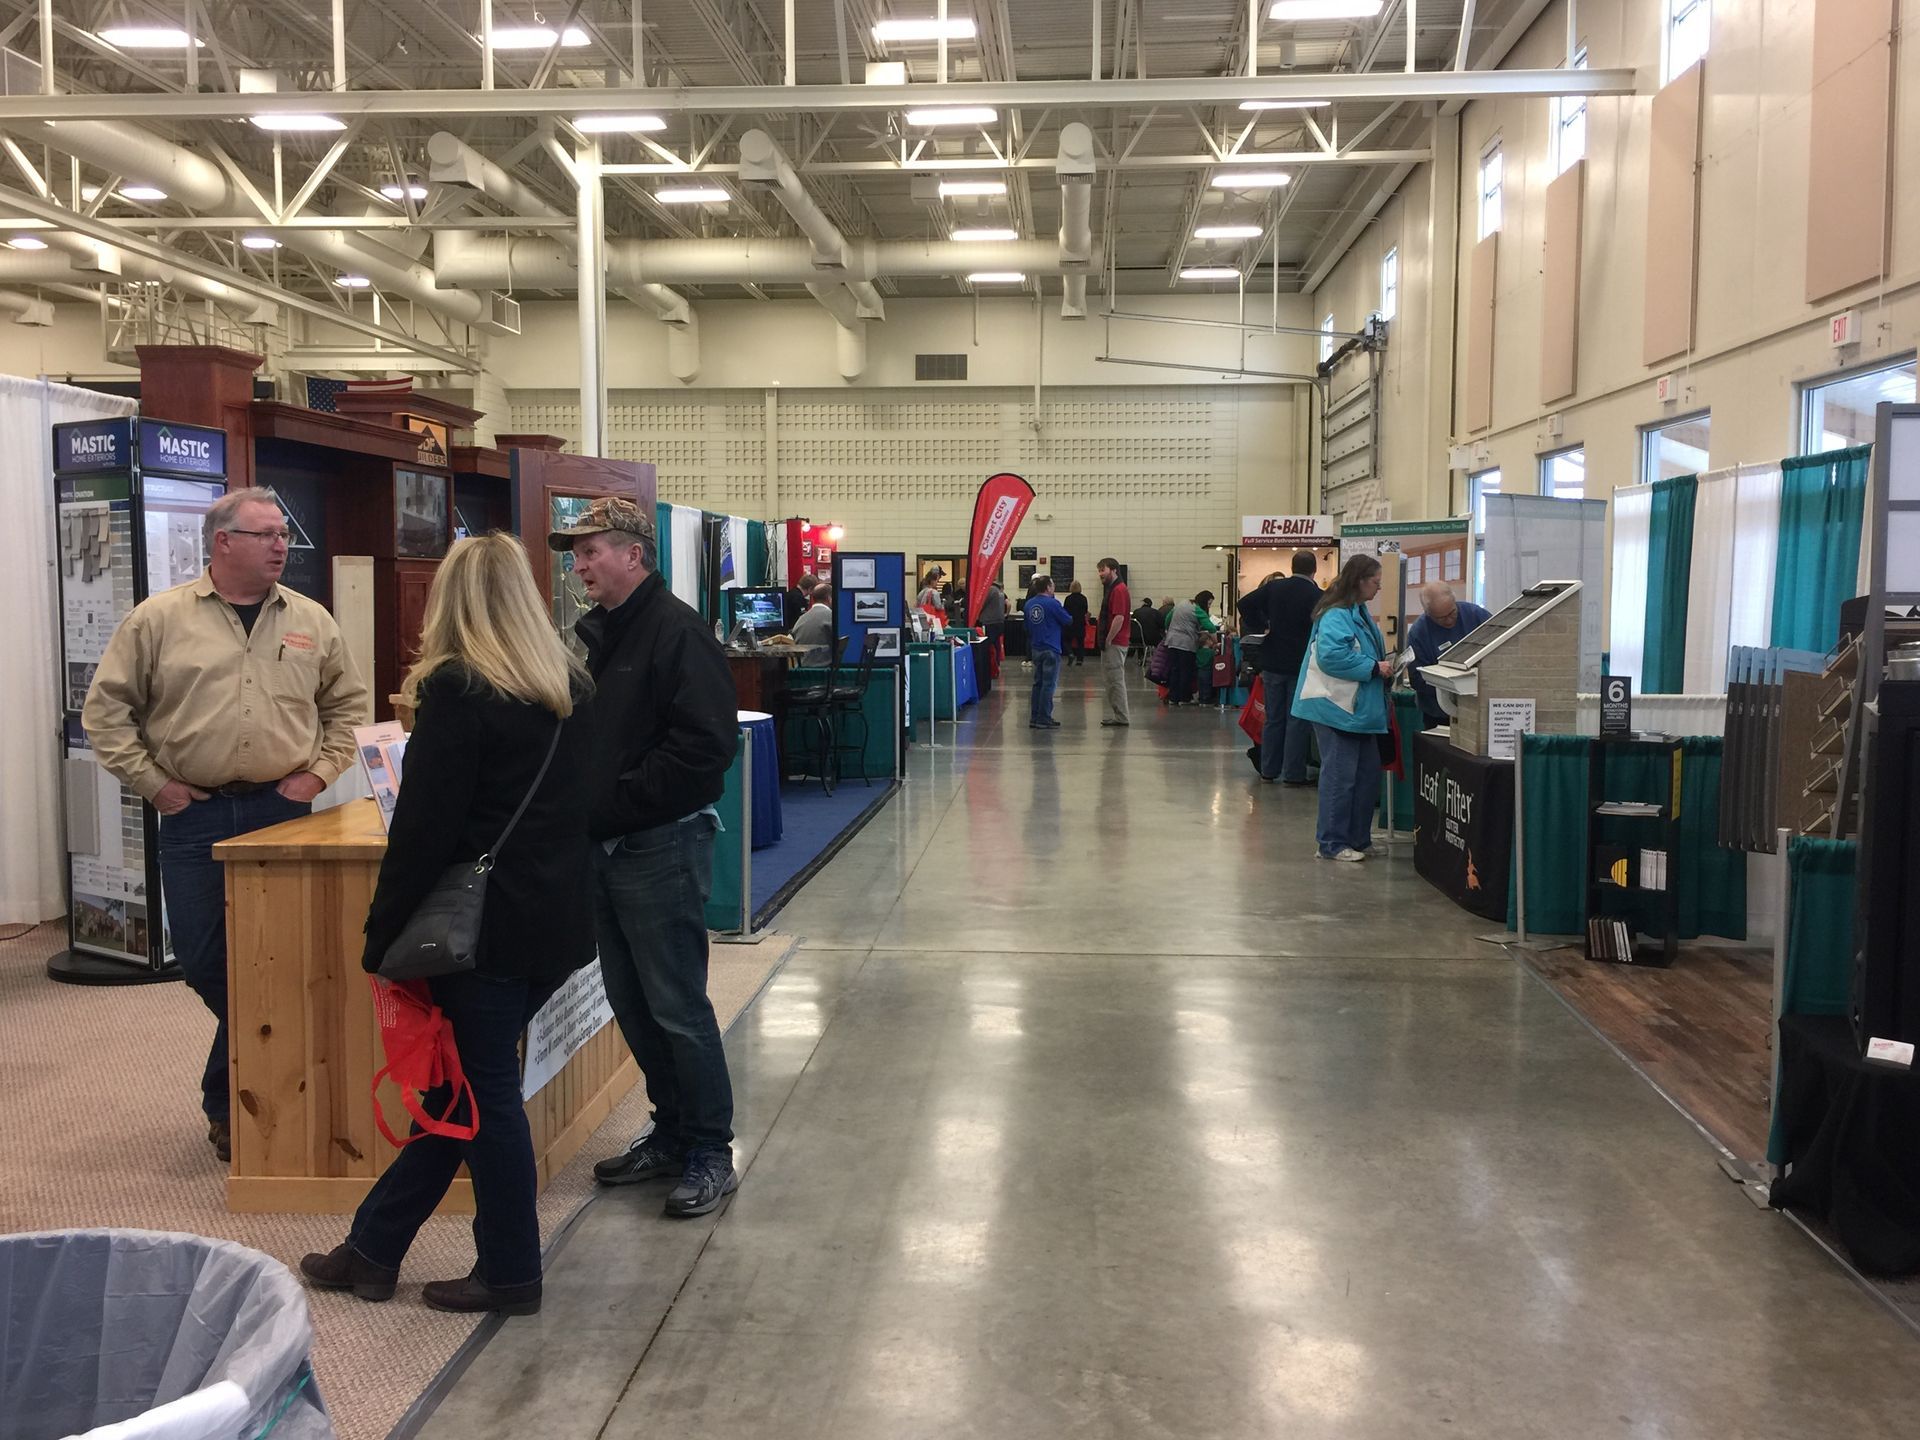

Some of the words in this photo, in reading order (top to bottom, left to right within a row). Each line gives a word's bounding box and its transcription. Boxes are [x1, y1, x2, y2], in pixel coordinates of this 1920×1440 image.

[1833, 317, 1847, 343] EXIT
[71, 434, 116, 455] MASTIC
[159, 436, 210, 459] MASTIC
[71, 454, 87, 464] HOME
[87, 452, 116, 463] EXTERIORS
[159, 454, 178, 464] HOME
[178, 457, 210, 468] EXTERIORS
[417, 450, 446, 466] UILDERS
[982, 519, 998, 550] Carpet
[994, 499, 1008, 520] City
[1300, 537, 1332, 545] Remodeling
[1342, 538, 1375, 551] Renewal
[1608, 680, 1625, 702] 6
[1419, 762, 1439, 807] Leaf
[1445, 778, 1474, 824] Filter
